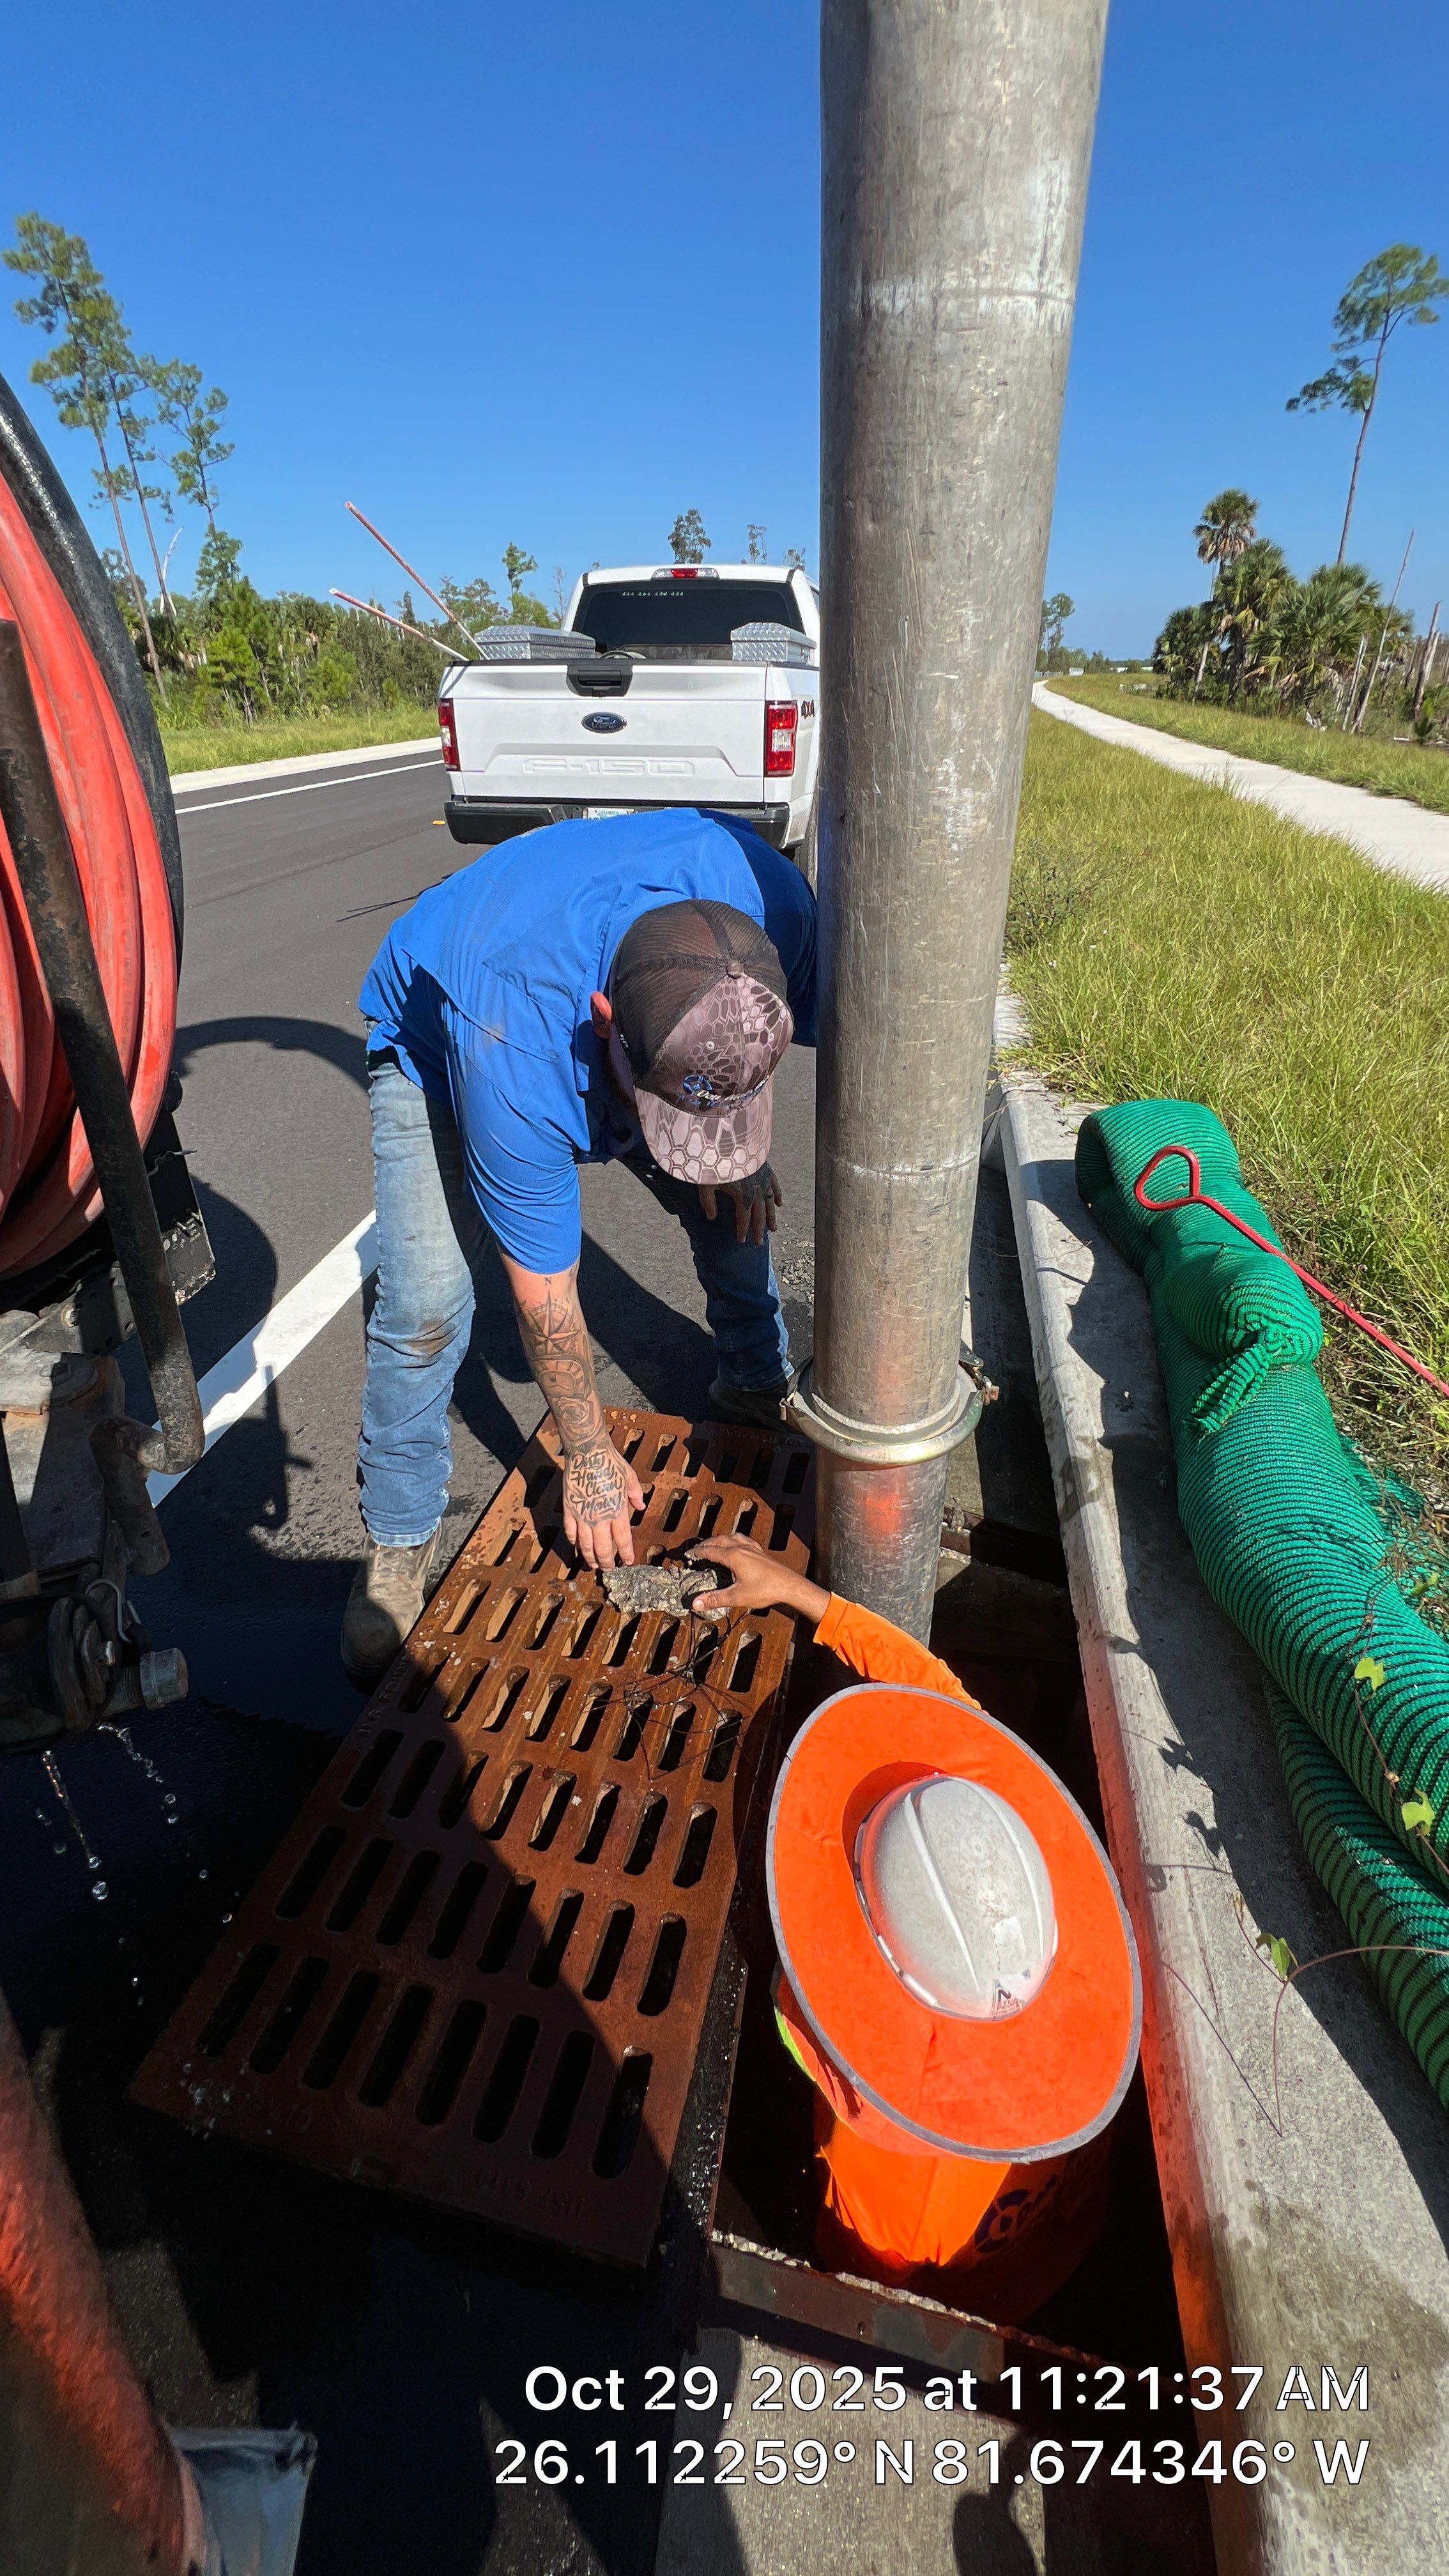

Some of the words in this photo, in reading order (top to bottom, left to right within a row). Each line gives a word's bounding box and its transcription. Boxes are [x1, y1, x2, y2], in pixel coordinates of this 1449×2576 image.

[592, 716, 616, 730] Ford
[523, 758, 695, 776] F-150
[572, 1450, 607, 1470] Dirty
[586, 1476, 623, 1497] Clean
